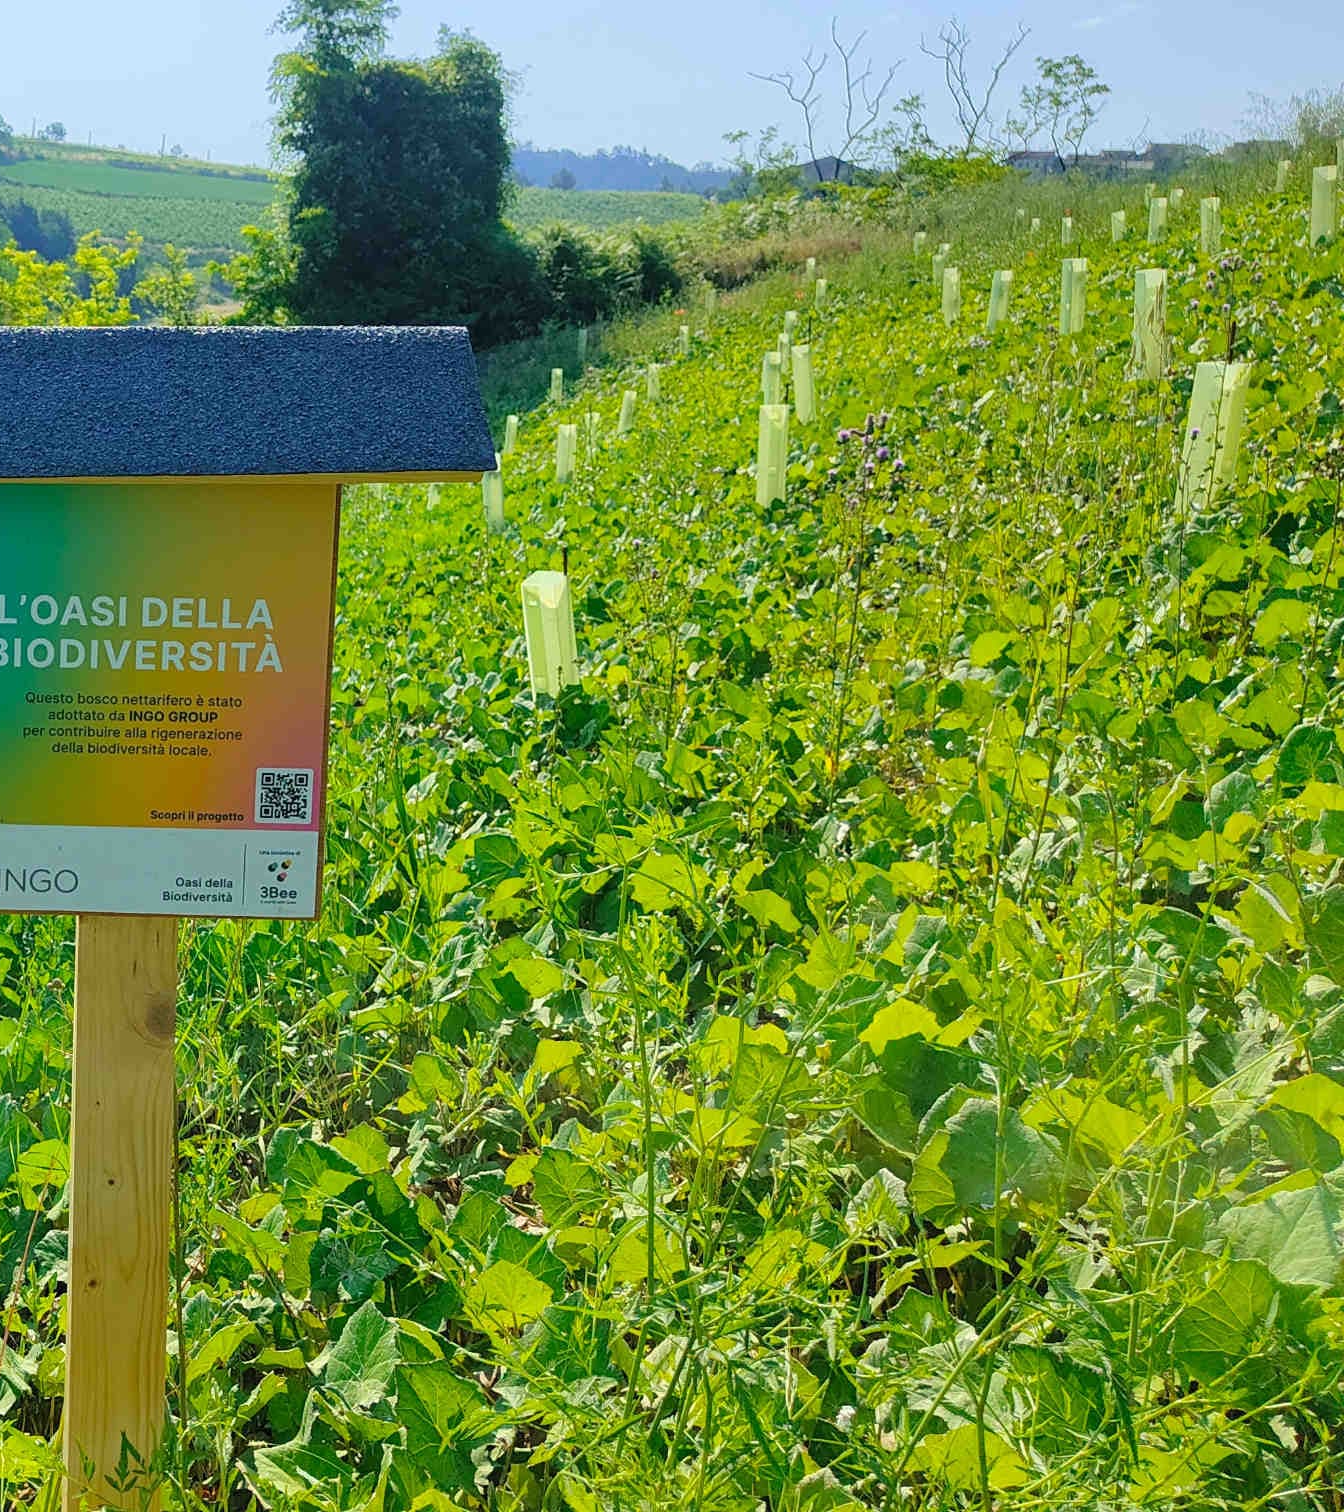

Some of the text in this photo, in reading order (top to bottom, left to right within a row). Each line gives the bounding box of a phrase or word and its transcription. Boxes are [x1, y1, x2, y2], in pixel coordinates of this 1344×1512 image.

[141, 597, 274, 630] DELLA
[25, 691, 242, 708] Questo bosco nettarifero è stato
[48, 709, 218, 723] adottato da INGO GROUP
[23, 724, 242, 741] per contribuire alla rigenerazione
[52, 742, 212, 757] della biodiversità locale.
[150, 810, 244, 824] Scopri il progetto
[175, 877, 233, 889] Oasi della
[162, 890, 233, 903] Biodiversità
[259, 886, 298, 899] 3Bee
